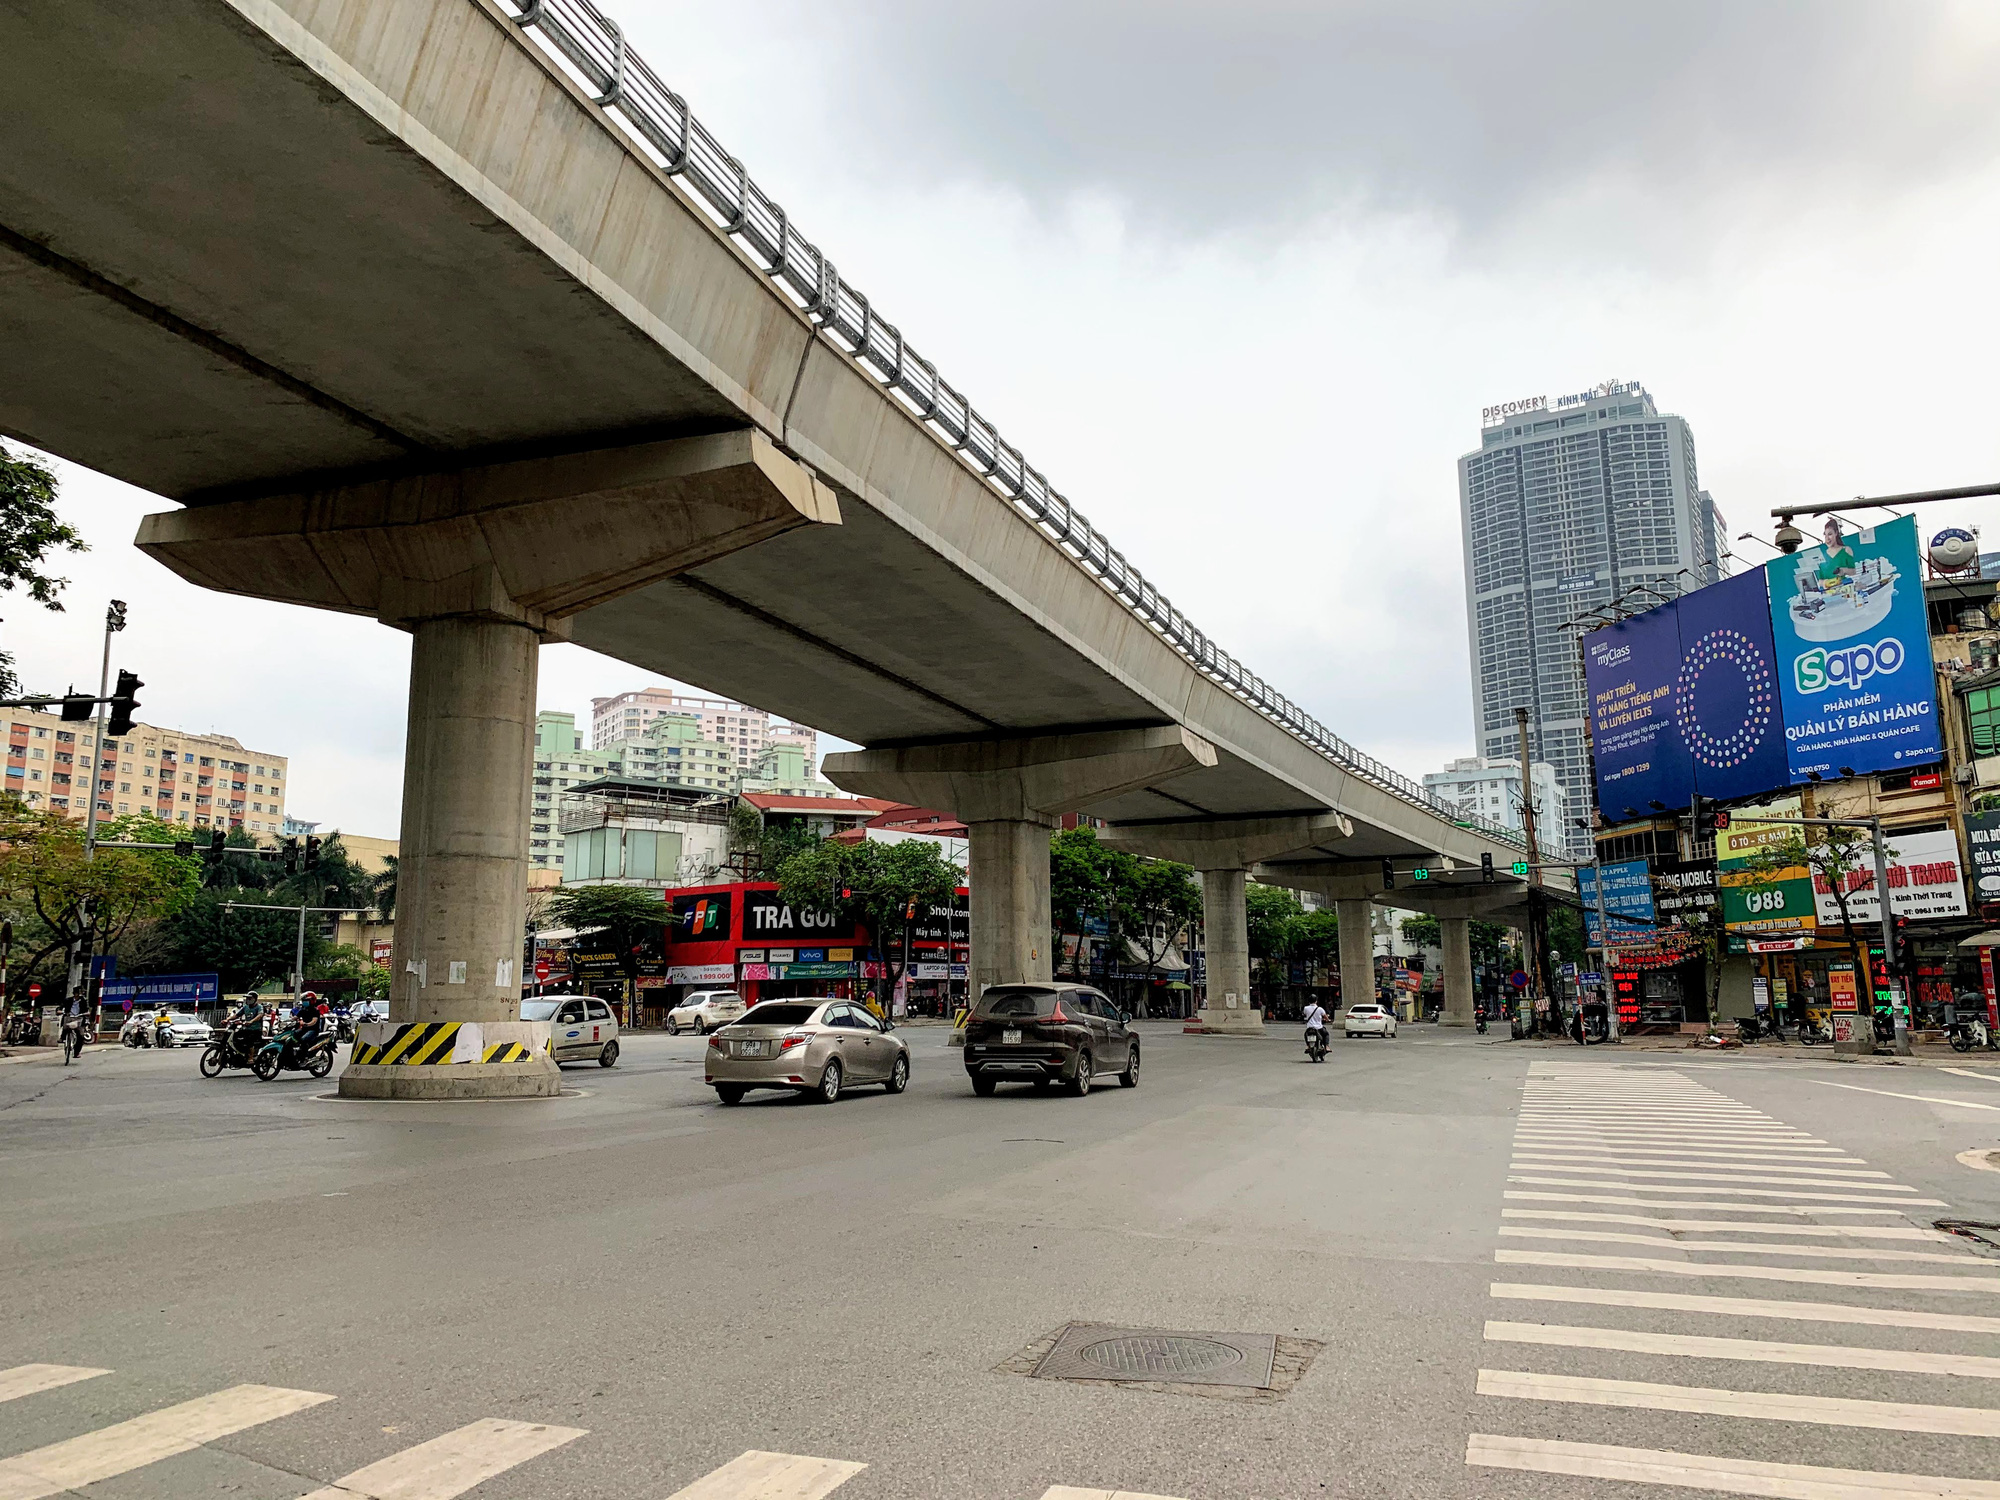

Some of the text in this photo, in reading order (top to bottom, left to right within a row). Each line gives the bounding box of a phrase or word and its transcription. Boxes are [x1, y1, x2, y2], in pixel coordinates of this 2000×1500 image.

[1482, 395, 1546, 418] DISCOVERY
[1597, 644, 1631, 666] myClass
[1596, 679, 1637, 704] PHÁT TRIỂN
[1630, 690, 1652, 707] TIẾNG
[1653, 684, 1670, 699] ANH
[1855, 692, 1881, 708] MỀM
[1598, 705, 1653, 731] VÀ LUYỆN IELTS
[1660, 719, 1670, 729] Anh
[1785, 700, 1930, 742] QUẢN LÝ BÁN HÀNG
[1833, 735, 1849, 747] NHÀ
[1850, 732, 1871, 744] HÀNG
[1900, 724, 1920, 735] CAFE
[1601, 746, 1608, 754] 20
[1905, 747, 1934, 758] Sapo.vn
[1622, 766, 1635, 777] 1800
[1636, 761, 1650, 773] 1299
[1731, 837, 1737, 848] Ô
[1738, 835, 1749, 847] TÔ
[1757, 833, 1767, 844] XE
[1971, 829, 1990, 844] MUA
[1414, 869, 1428, 880] 03
[1512, 862, 1529, 875] 03
[1608, 866, 1629, 875] APPLE
[1909, 861, 1957, 886] TRANG
[1659, 869, 1713, 890] TÙNG MOBILE
[1931, 891, 1953, 901] Trang
[916, 927, 928, 938] Máy
